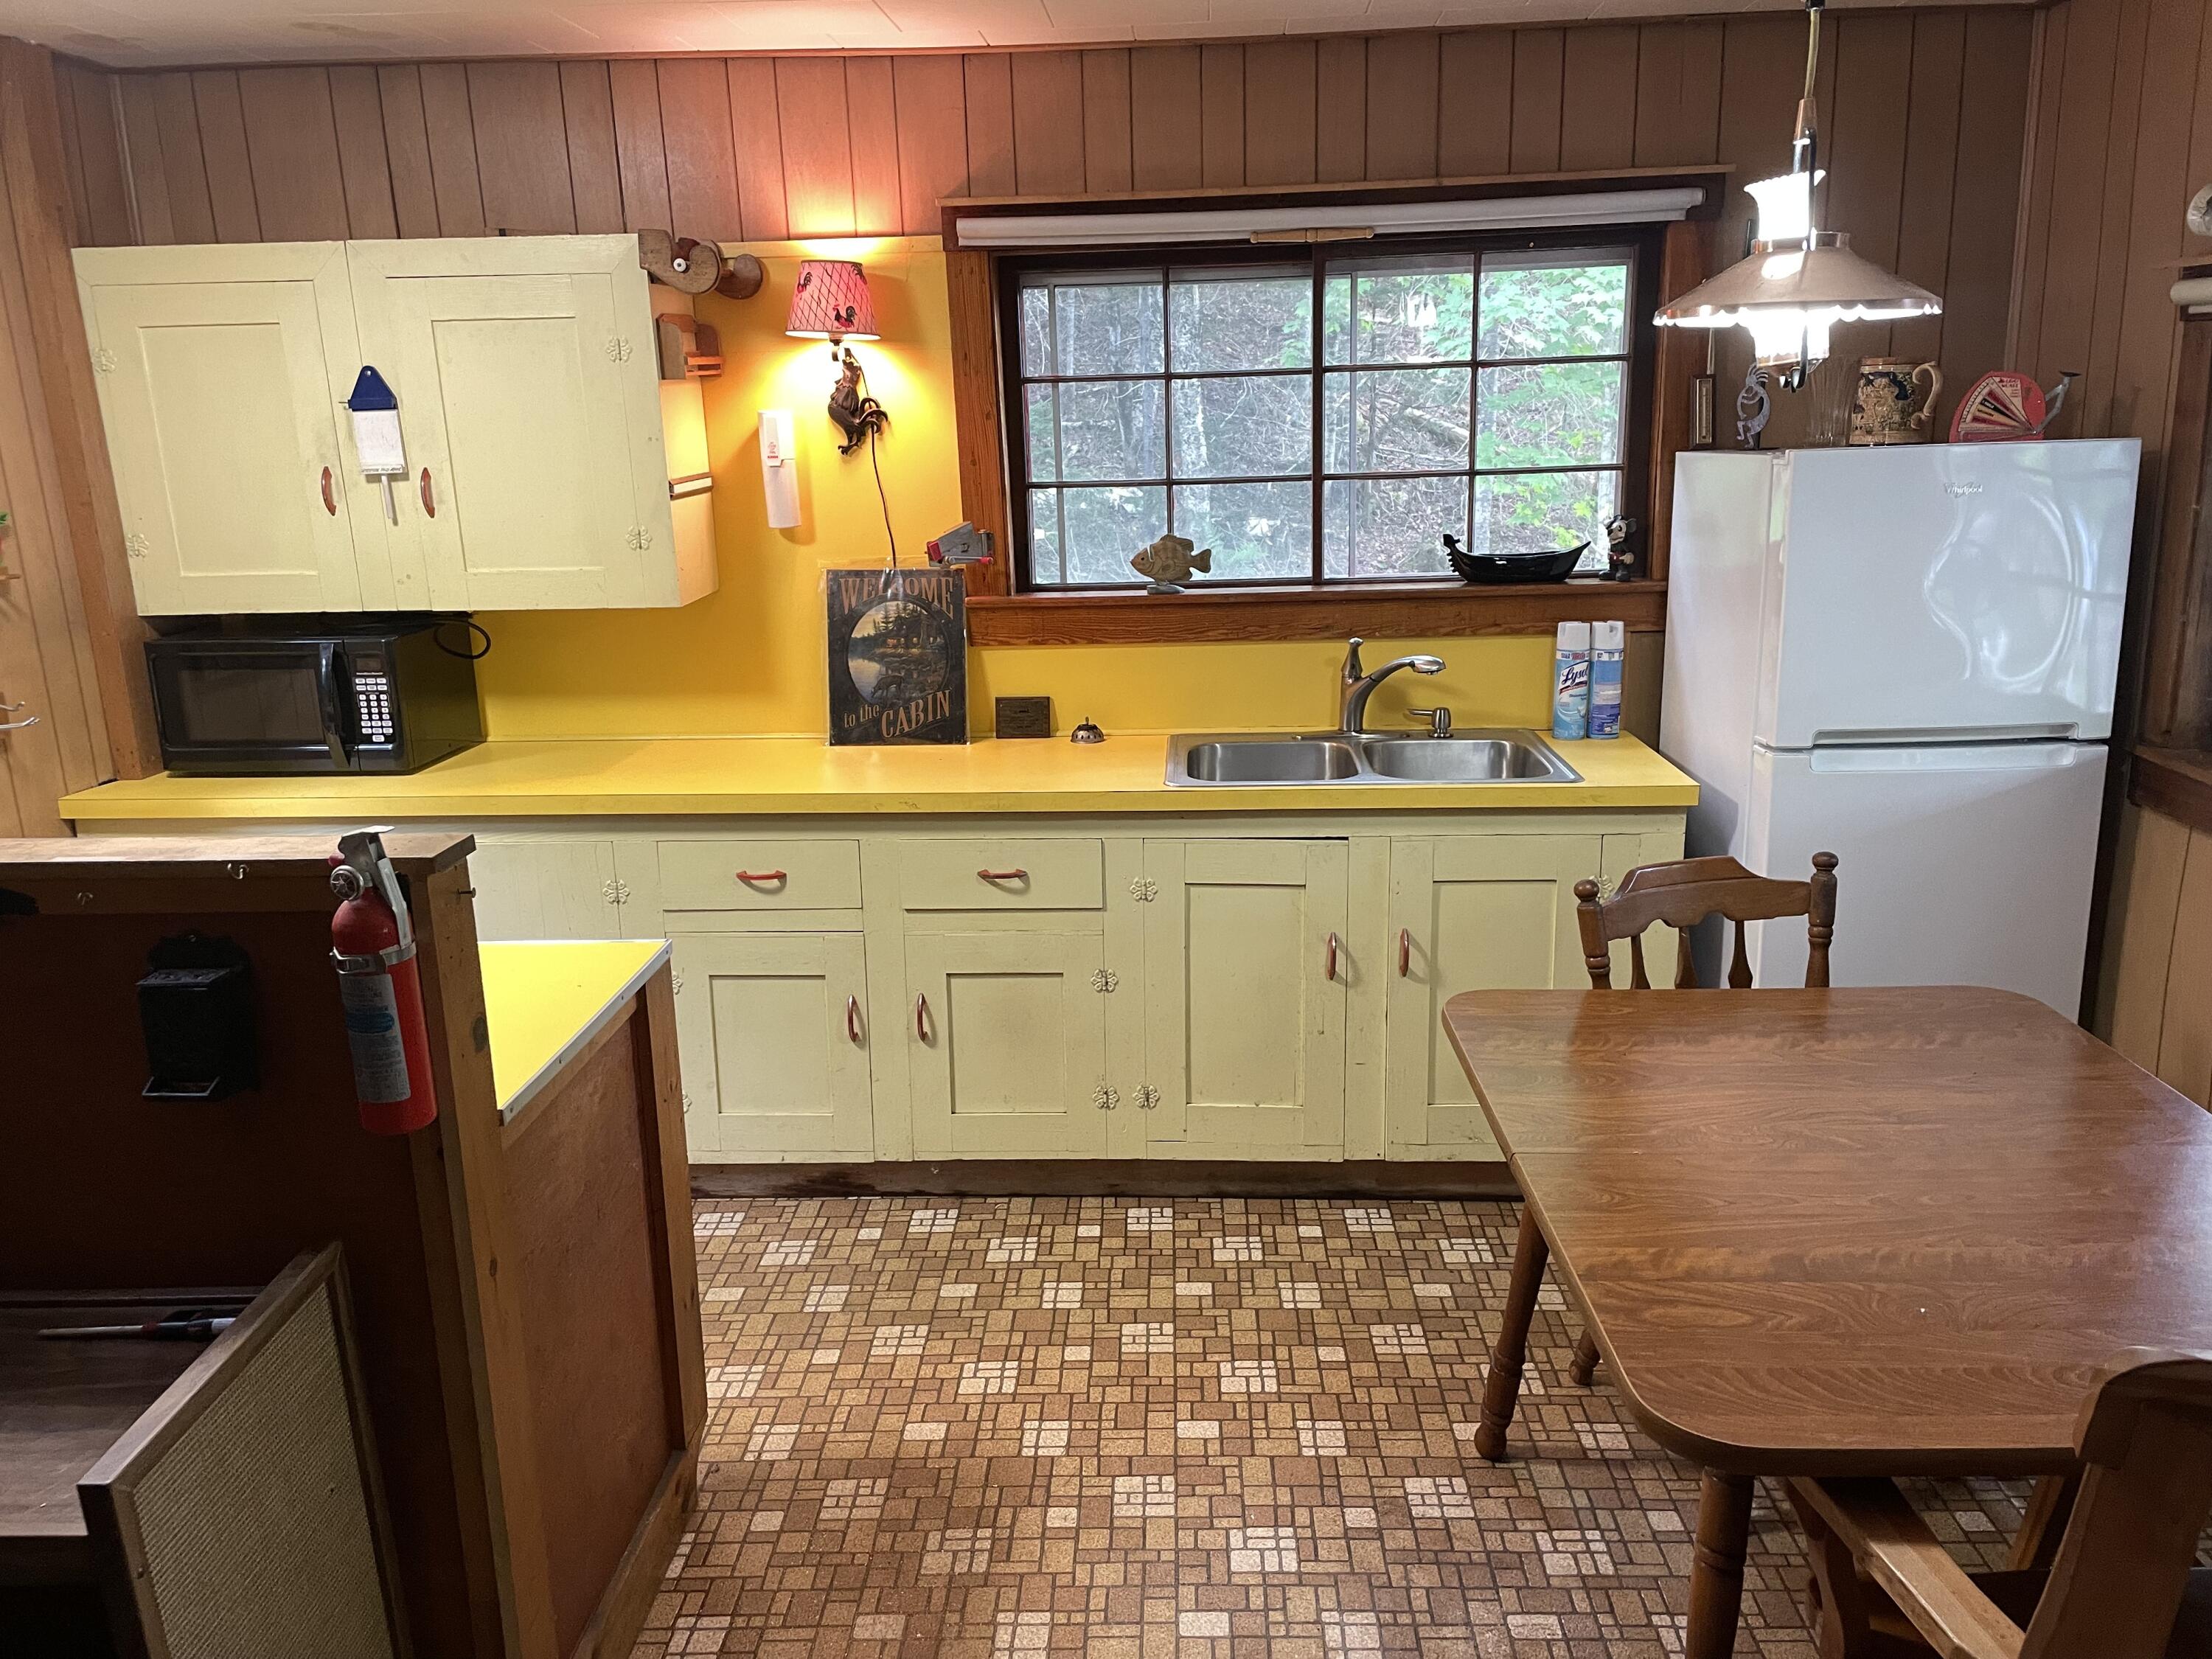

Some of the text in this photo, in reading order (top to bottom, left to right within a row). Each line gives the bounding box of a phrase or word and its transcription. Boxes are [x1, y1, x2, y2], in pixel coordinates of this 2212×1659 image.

[1944, 483, 1983, 495] Whirlpool
[838, 577, 953, 619] WELCOME
[1562, 664, 1588, 685] Lysol
[844, 704, 880, 728] to the
[881, 689, 951, 738] CABIN
